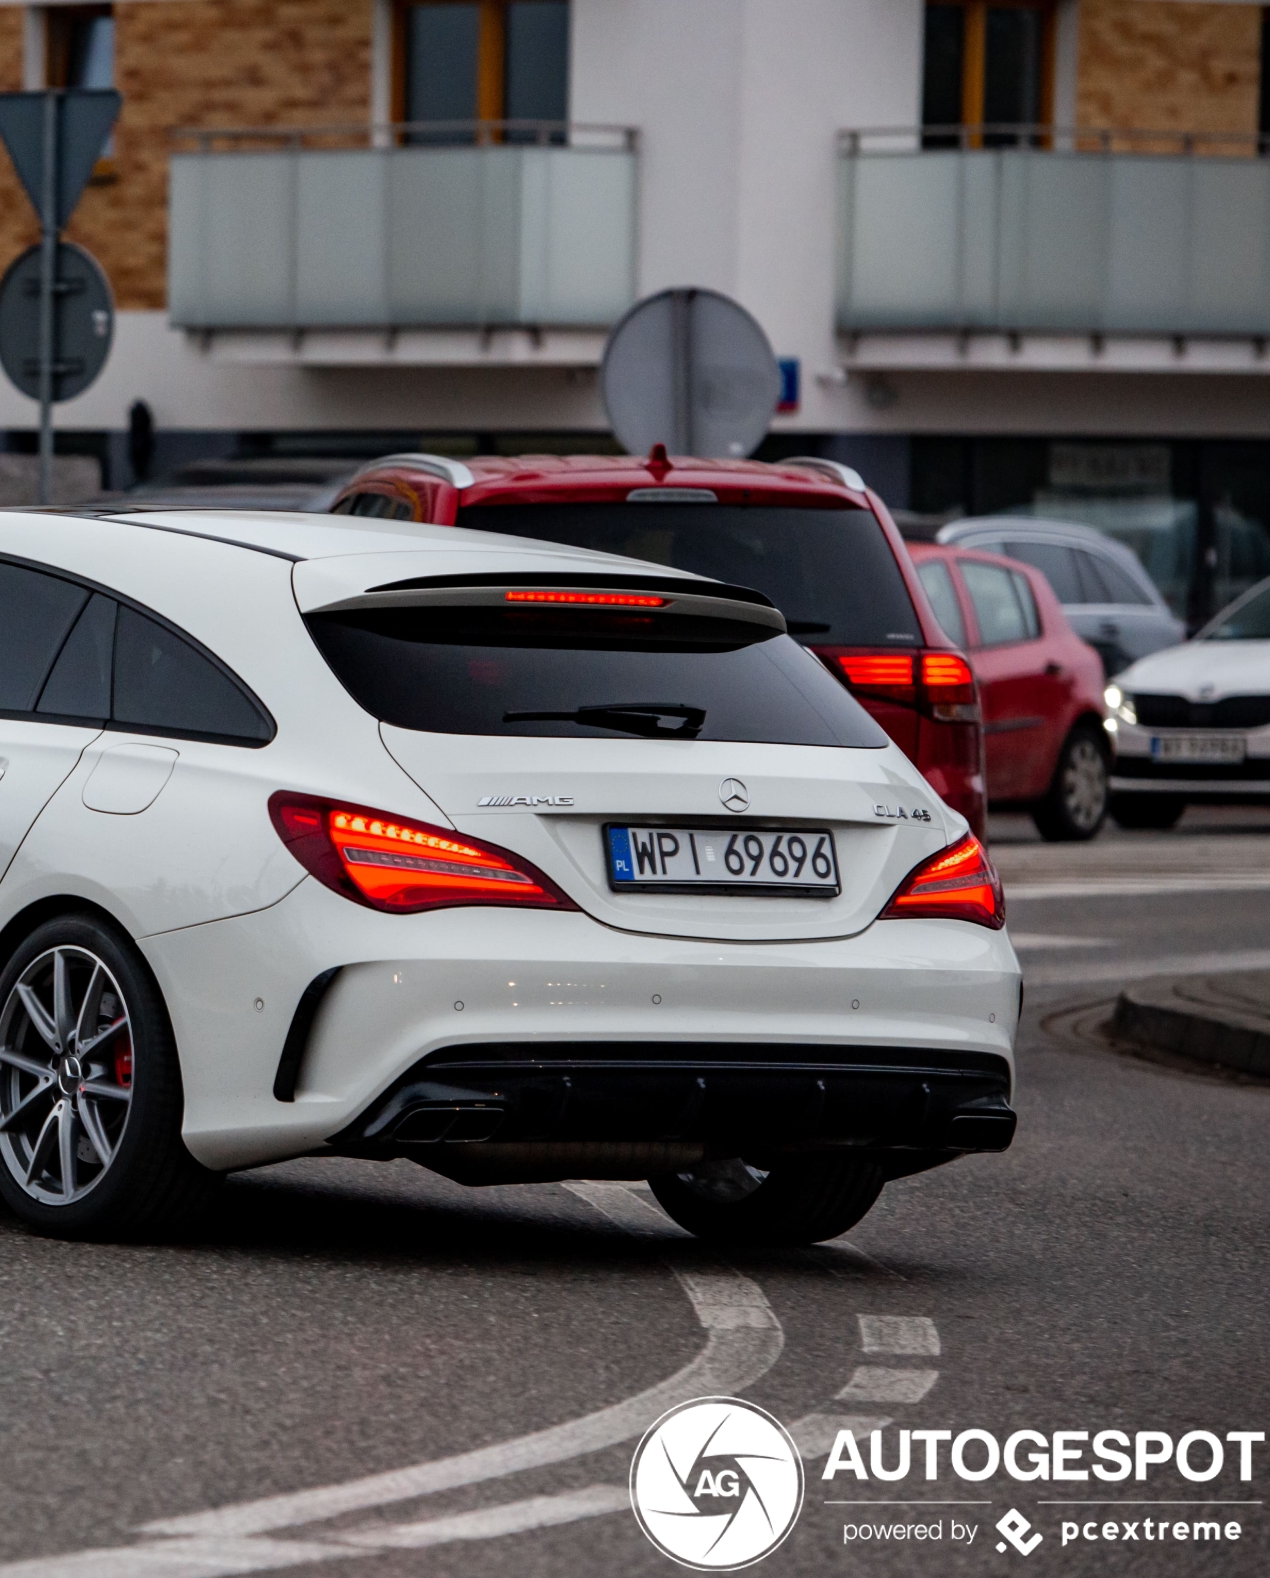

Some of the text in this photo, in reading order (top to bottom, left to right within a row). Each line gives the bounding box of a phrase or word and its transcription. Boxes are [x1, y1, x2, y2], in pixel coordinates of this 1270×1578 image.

[508, 796, 574, 806] AMG
[873, 803, 932, 822] CLA 45
[631, 831, 832, 879] WPI 69696
[615, 860, 630, 872] PL
